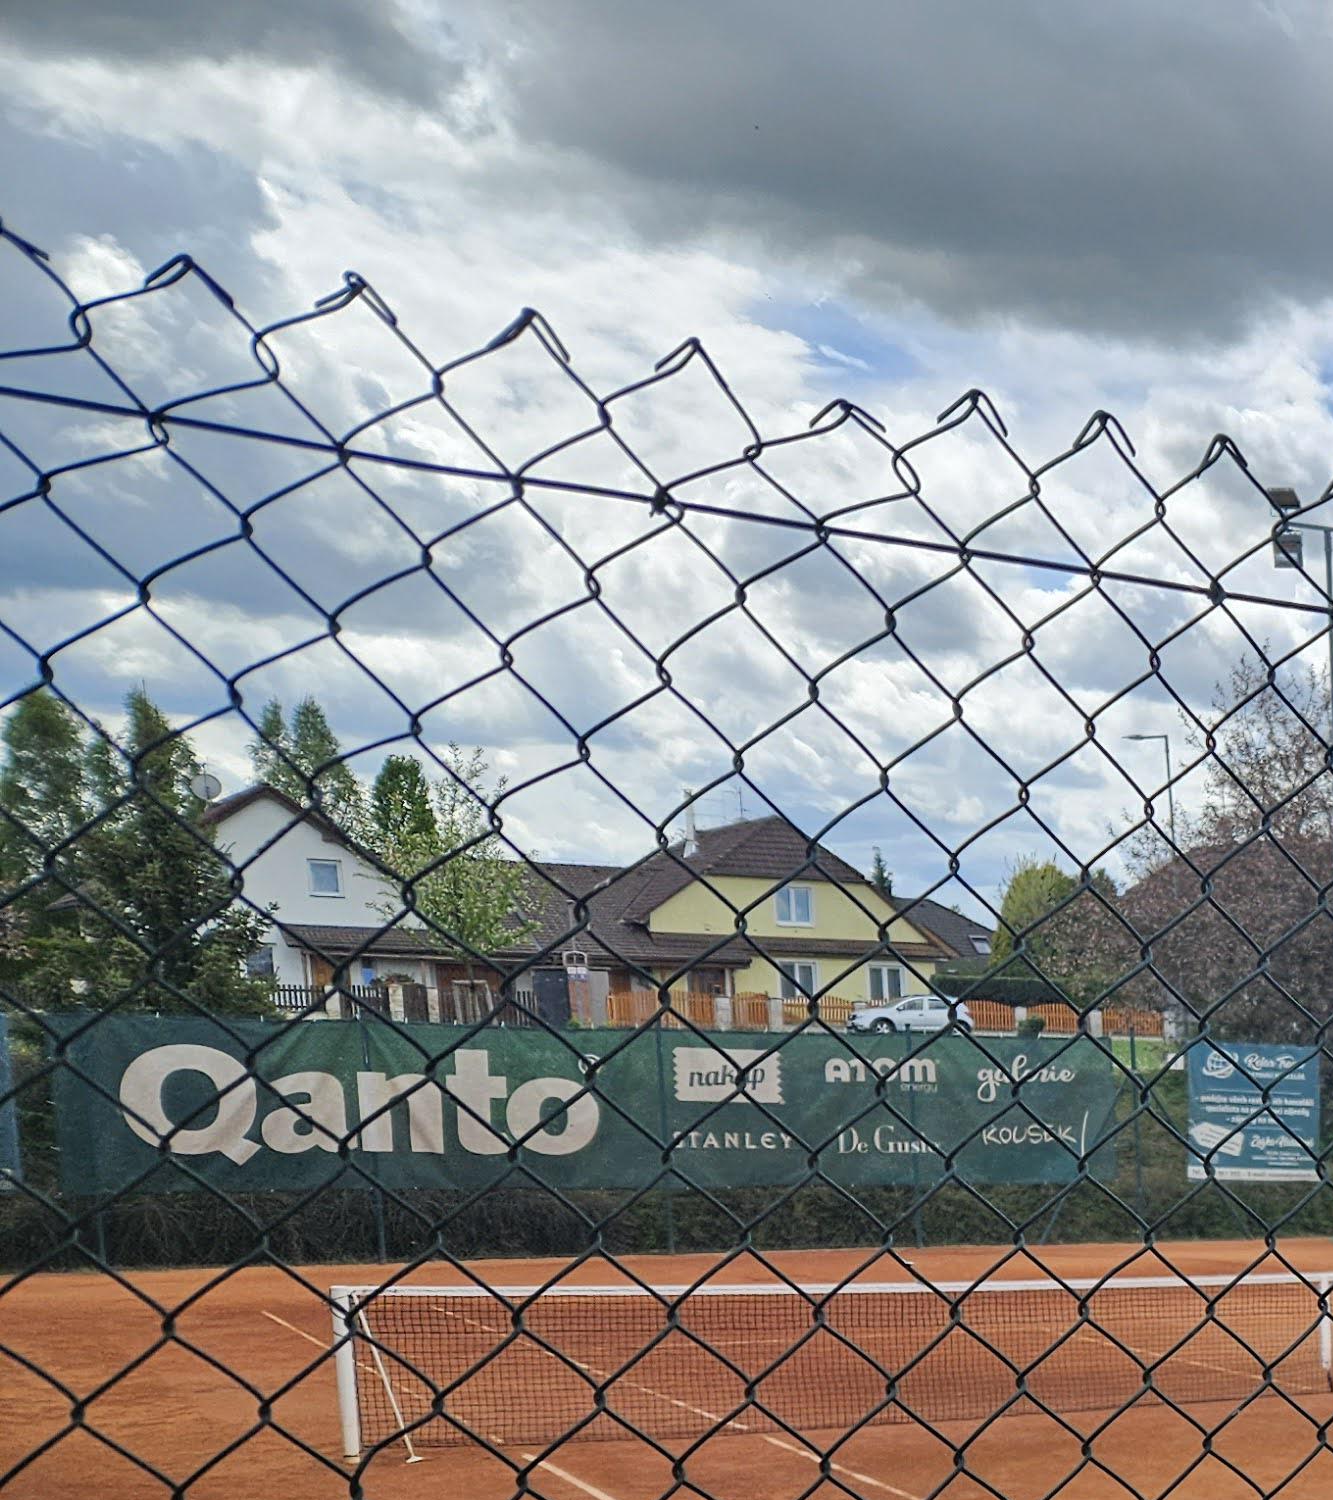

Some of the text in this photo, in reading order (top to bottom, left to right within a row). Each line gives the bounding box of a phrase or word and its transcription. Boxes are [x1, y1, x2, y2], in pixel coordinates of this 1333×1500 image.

[688, 1065, 766, 1091] nakp
[120, 1044, 599, 1166] Qanto
[672, 1131, 794, 1149] STANLEY
[837, 1125, 940, 1154] De Gust
